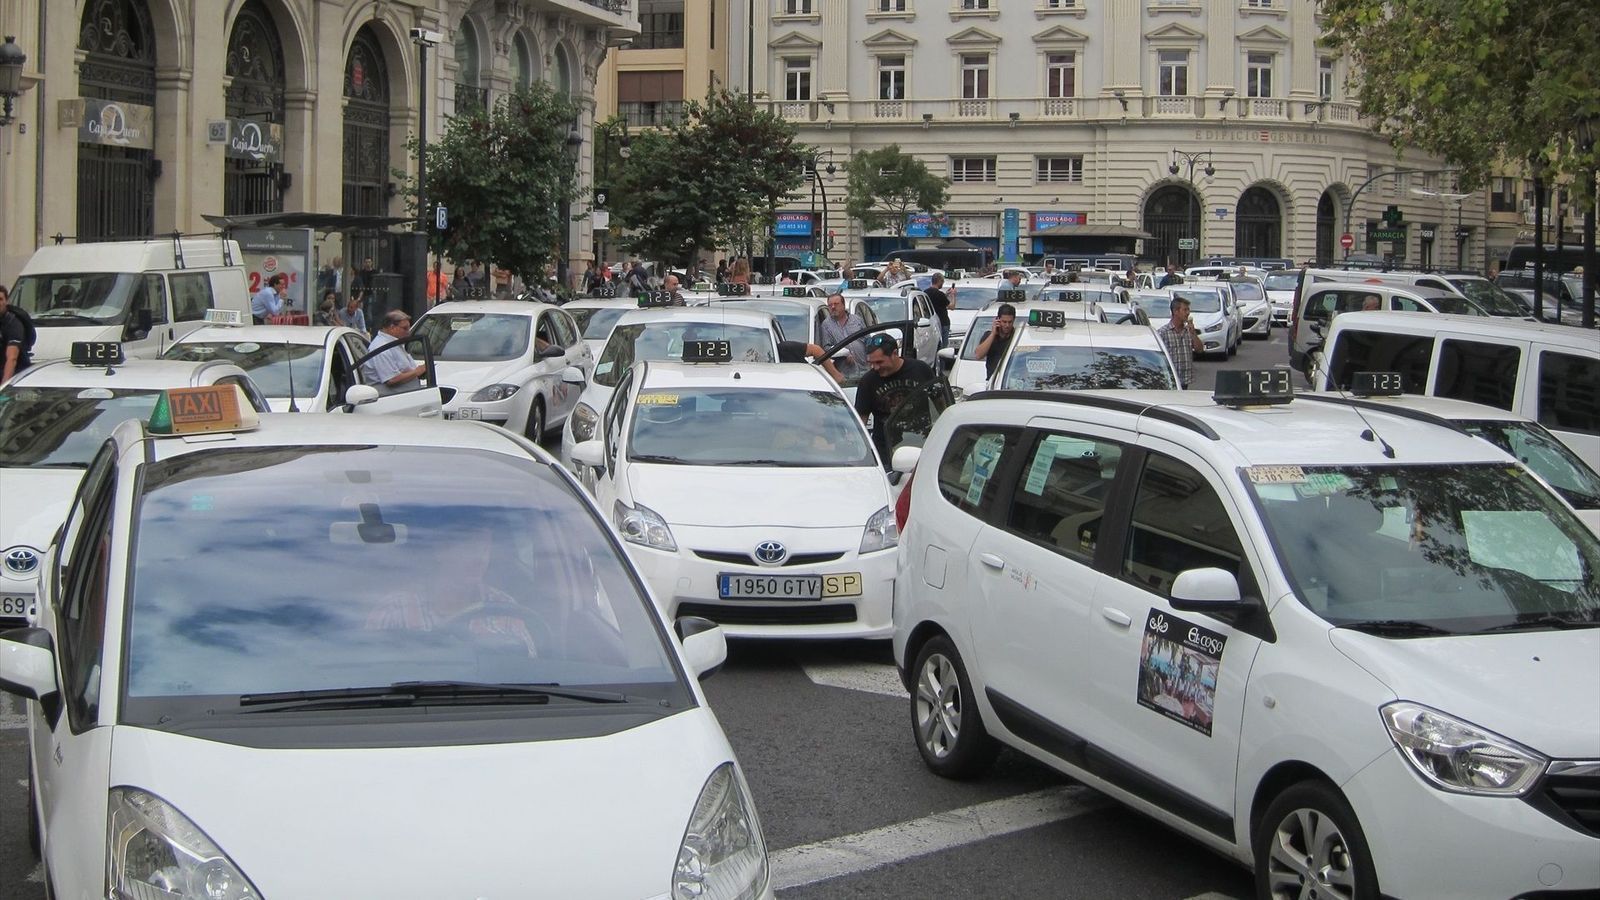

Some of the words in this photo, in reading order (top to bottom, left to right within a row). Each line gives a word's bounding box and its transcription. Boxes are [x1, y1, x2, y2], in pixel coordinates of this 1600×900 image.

[232, 137, 248, 153] Caja
[1195, 130, 1259, 141] EDIFICIO
[1271, 131, 1329, 145] GENERALI
[1369, 231, 1405, 240] FARMACIA
[249, 272, 261, 293] 2
[726, 285, 745, 293] 123
[649, 291, 672, 302] 123
[1005, 291, 1025, 299] 123
[1065, 291, 1080, 299] 123
[1039, 312, 1063, 323] 123
[86, 343, 119, 358] 123
[697, 341, 728, 356] 123
[1246, 370, 1289, 393] 123
[1371, 374, 1401, 390] 123
[170, 392, 219, 416] TAXI
[735, 578, 777, 595] 1950
[783, 579, 817, 596] GTV
